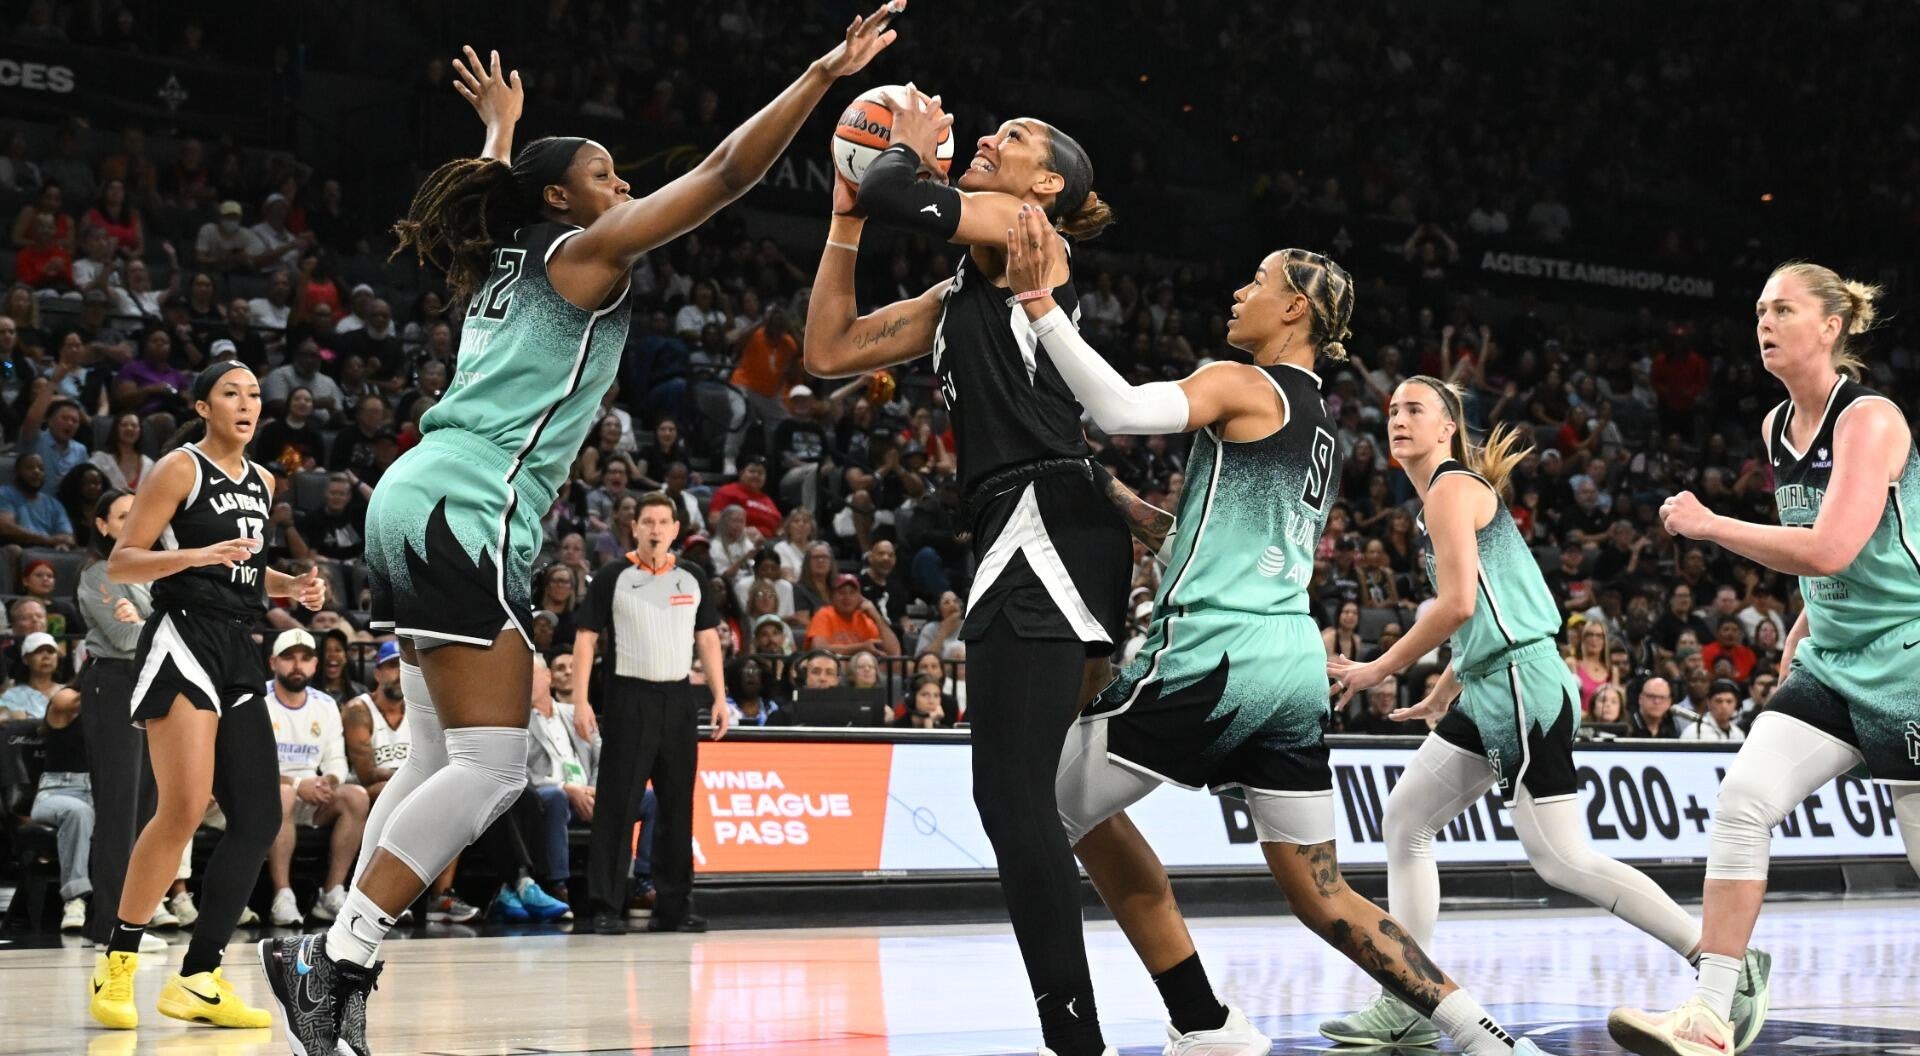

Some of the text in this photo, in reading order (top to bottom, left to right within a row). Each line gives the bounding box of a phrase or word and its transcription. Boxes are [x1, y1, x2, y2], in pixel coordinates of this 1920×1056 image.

[1479, 250, 1714, 298] ACESTEAMSHOP.COM
[1301, 426, 1335, 514] 9
[209, 492, 238, 515] LAS
[236, 516, 264, 554] 13
[700, 771, 785, 790] WNBA
[708, 793, 853, 818] LEAGUE
[1576, 765, 1710, 841] 200+
[713, 820, 810, 845] PASS
